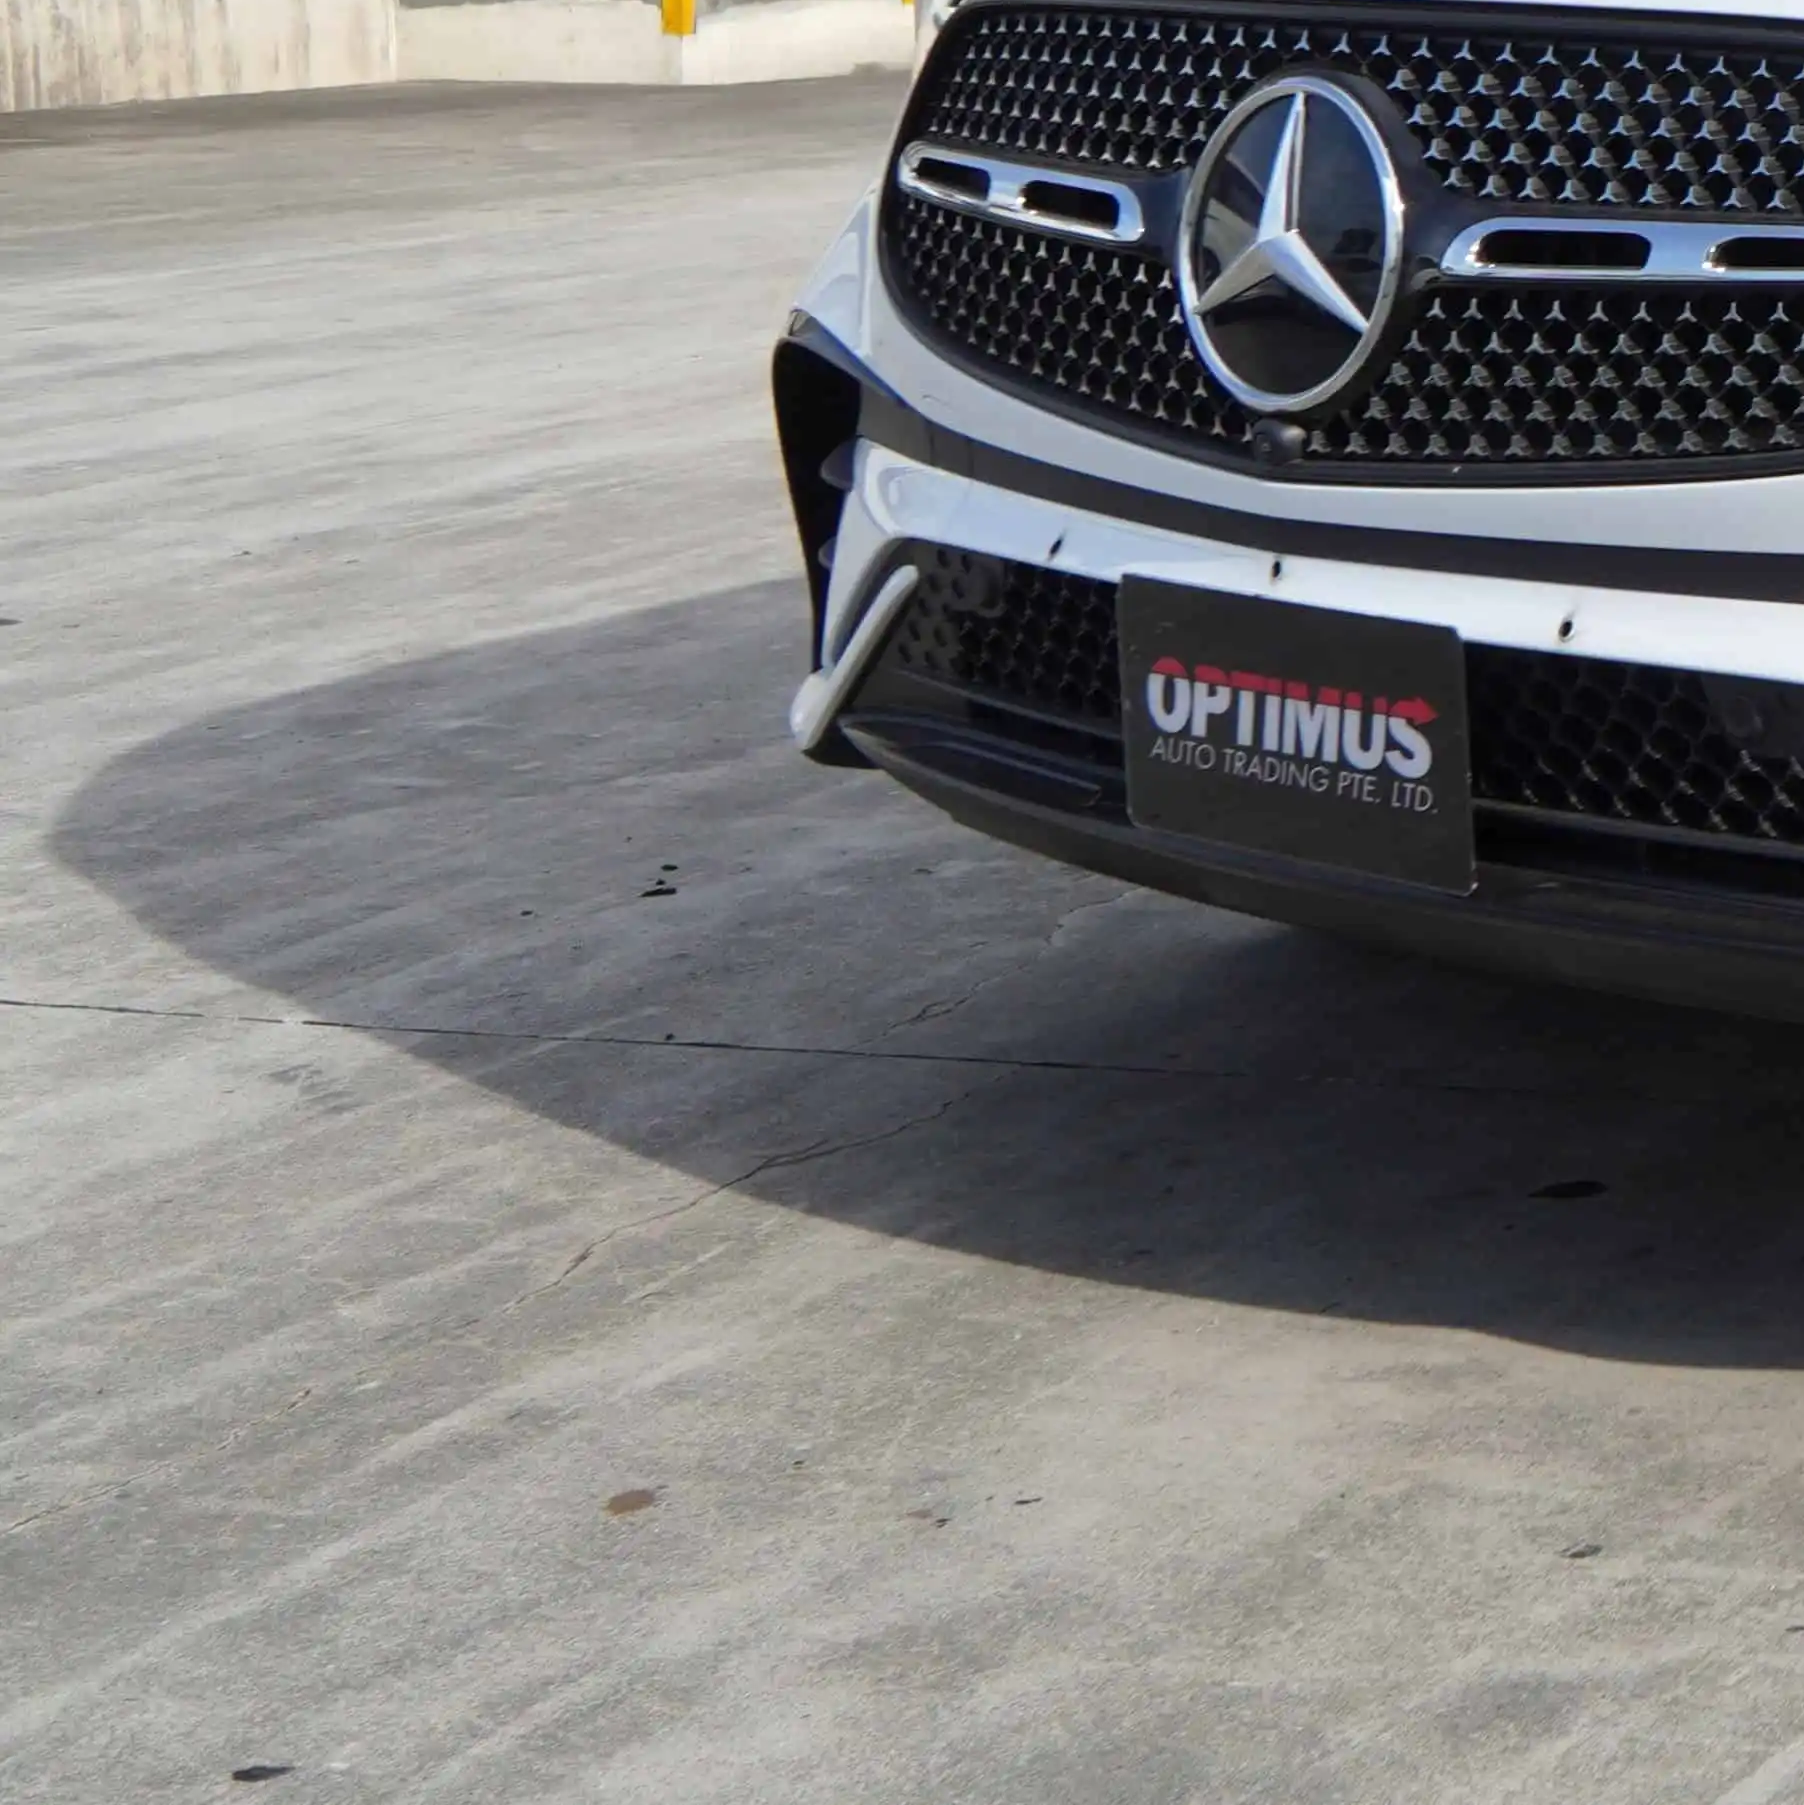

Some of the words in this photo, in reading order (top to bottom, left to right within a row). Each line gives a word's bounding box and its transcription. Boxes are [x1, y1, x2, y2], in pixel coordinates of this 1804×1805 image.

[1145, 656, 1438, 780] OPTIMUS
[1149, 735, 1217, 770] AUTO
[1222, 747, 1330, 793] TRADING
[1337, 770, 1381, 804] PTE.
[1391, 781, 1439, 815] LTD.
